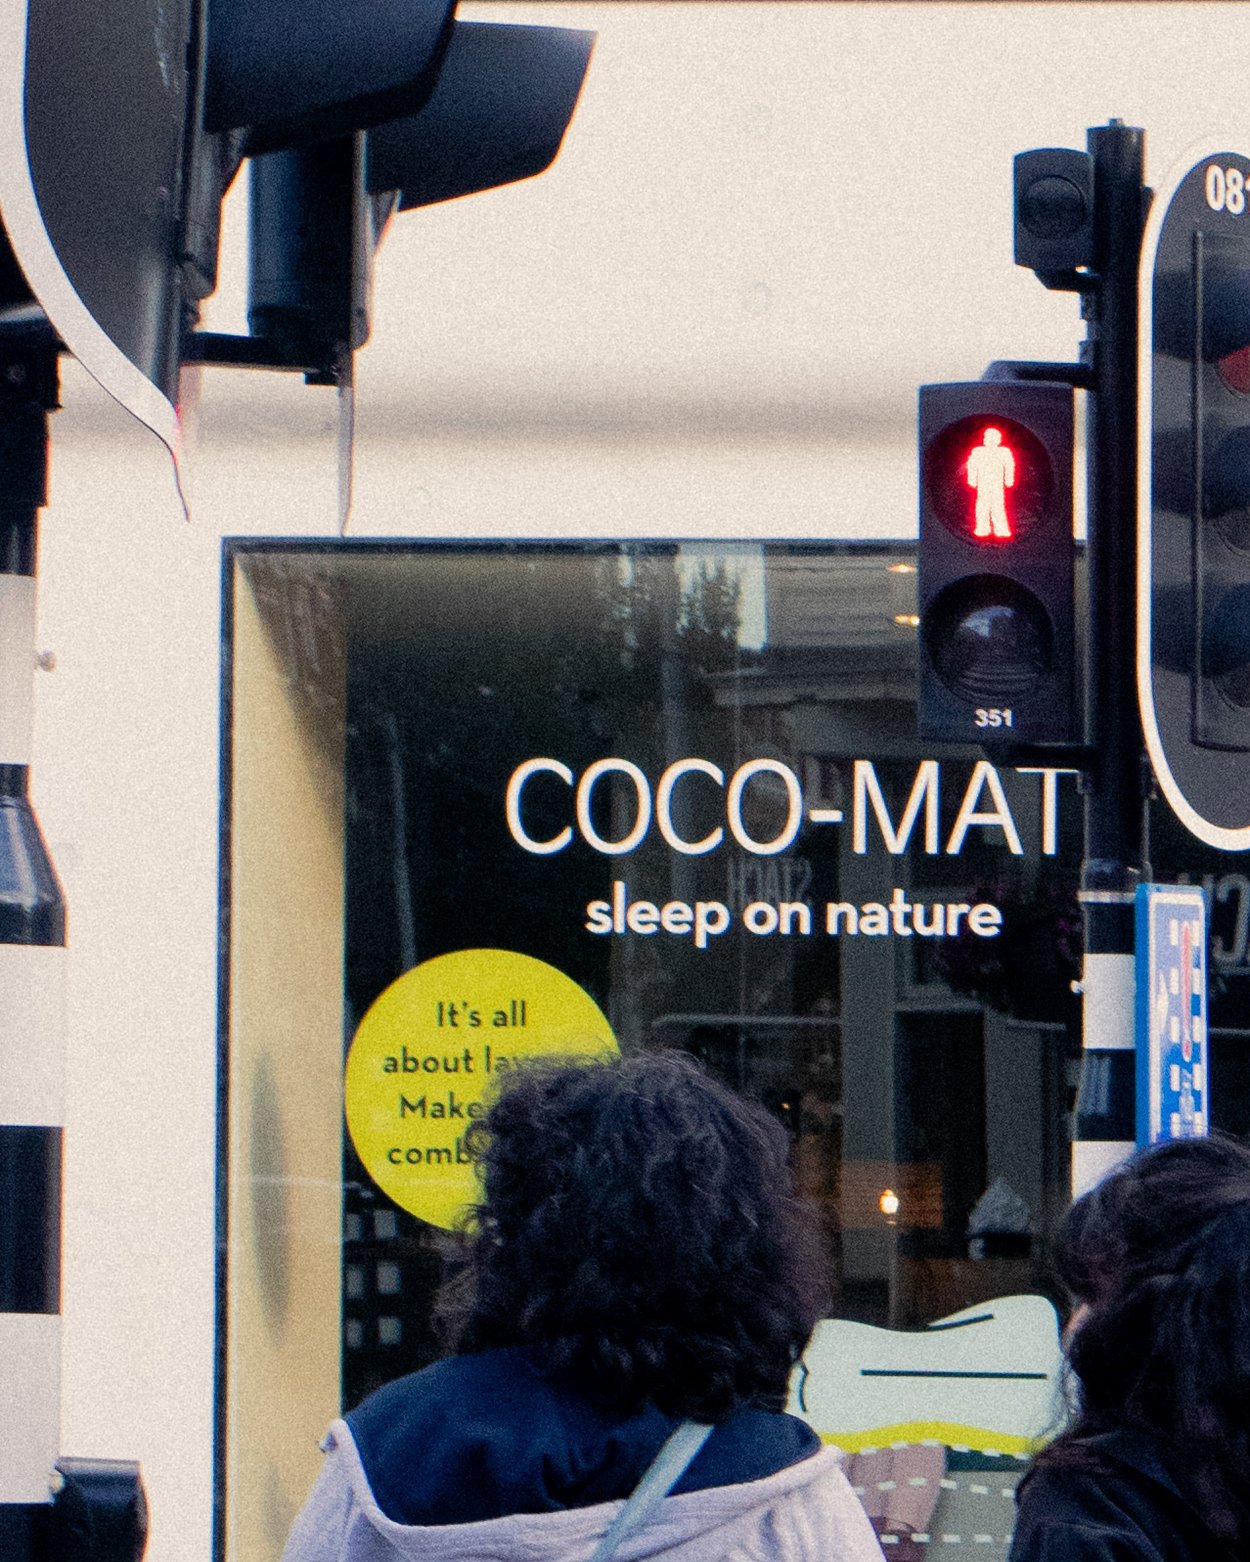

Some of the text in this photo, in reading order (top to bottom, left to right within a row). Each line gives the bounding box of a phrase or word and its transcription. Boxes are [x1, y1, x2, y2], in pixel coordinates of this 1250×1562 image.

[974, 708, 1013, 728] 351
[505, 757, 1080, 855] COCO-MAT
[585, 880, 1003, 947] sleep on nature
[437, 999, 526, 1027] It's all
[383, 1045, 472, 1073] about
[400, 1091, 486, 1118] Make
[387, 1136, 474, 1164] comb
